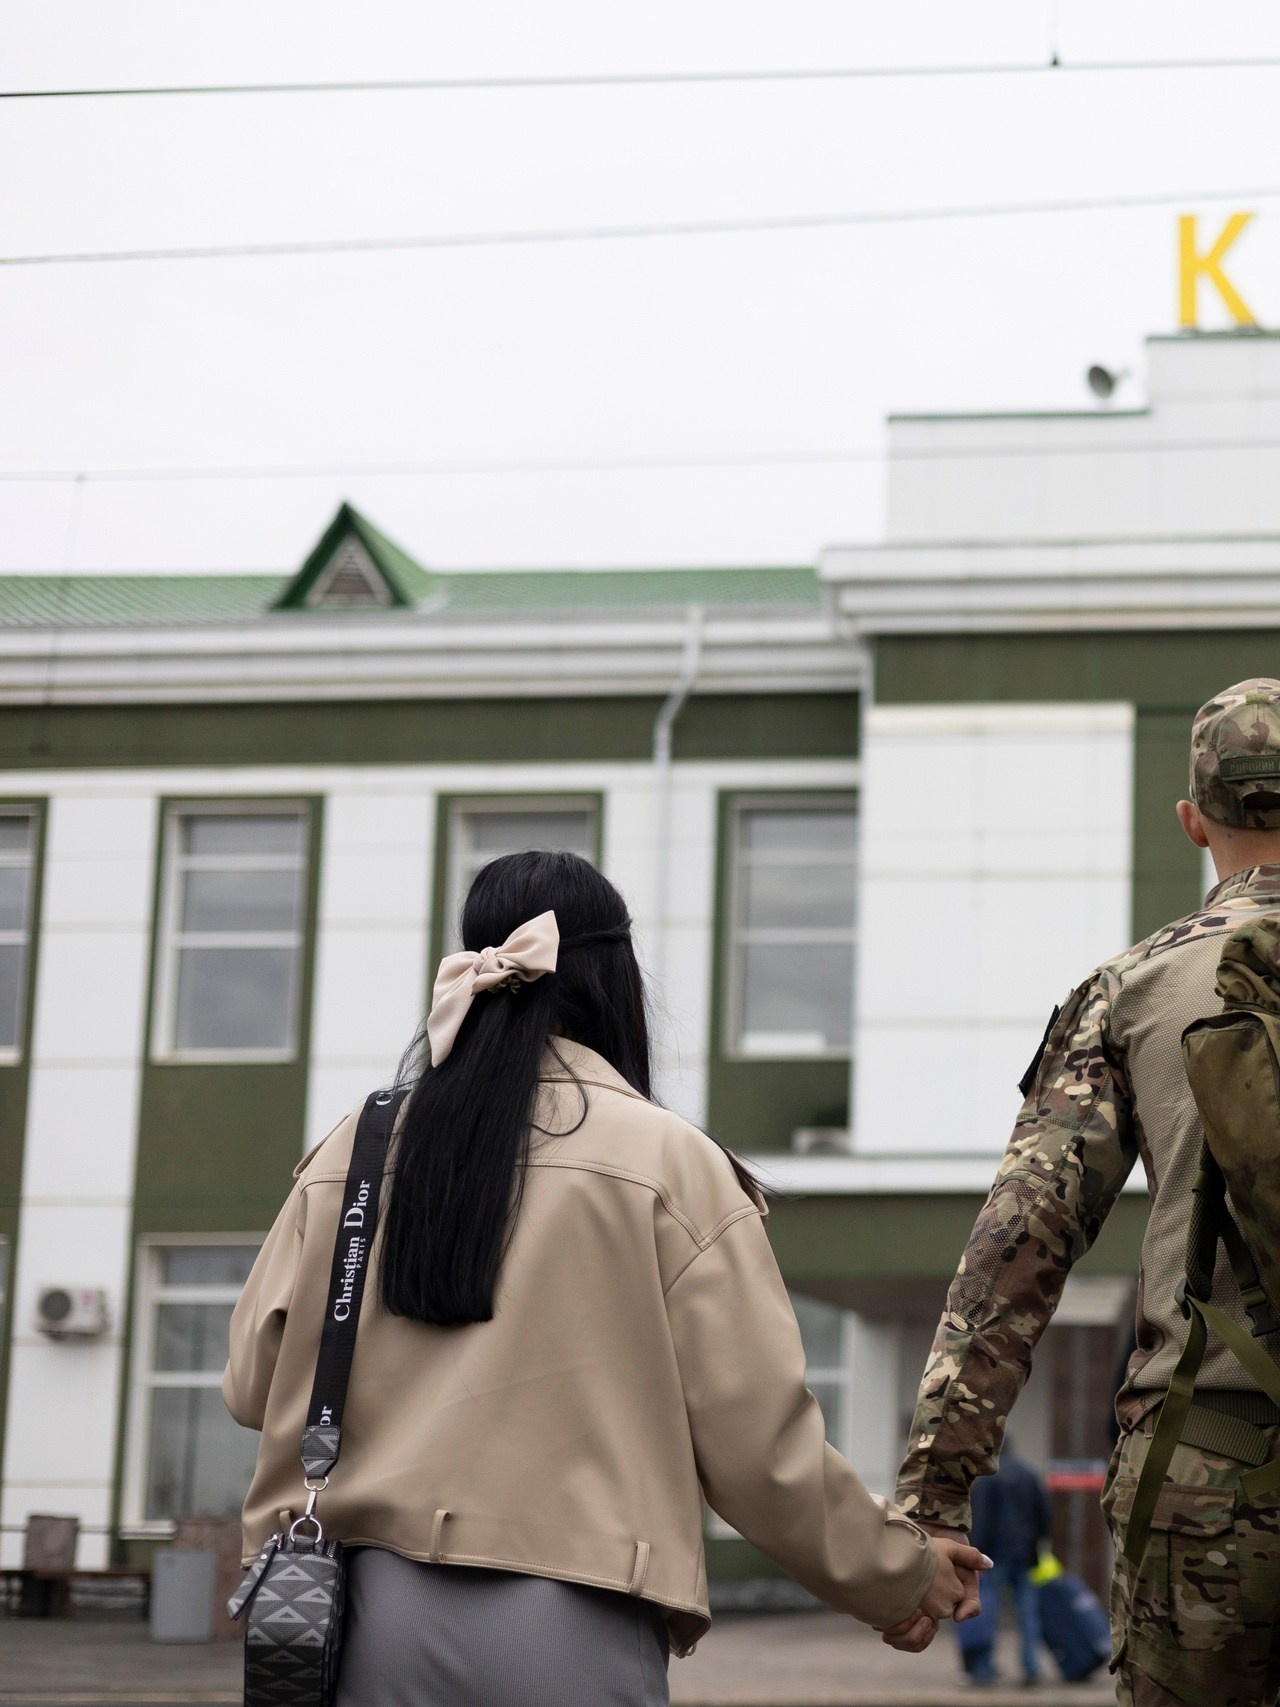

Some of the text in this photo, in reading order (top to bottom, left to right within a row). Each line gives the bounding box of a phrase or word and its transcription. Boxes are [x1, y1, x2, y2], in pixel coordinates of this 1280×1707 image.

[333, 1179, 371, 1322] Christian Dior
[355, 1237, 367, 1269] PARIS
